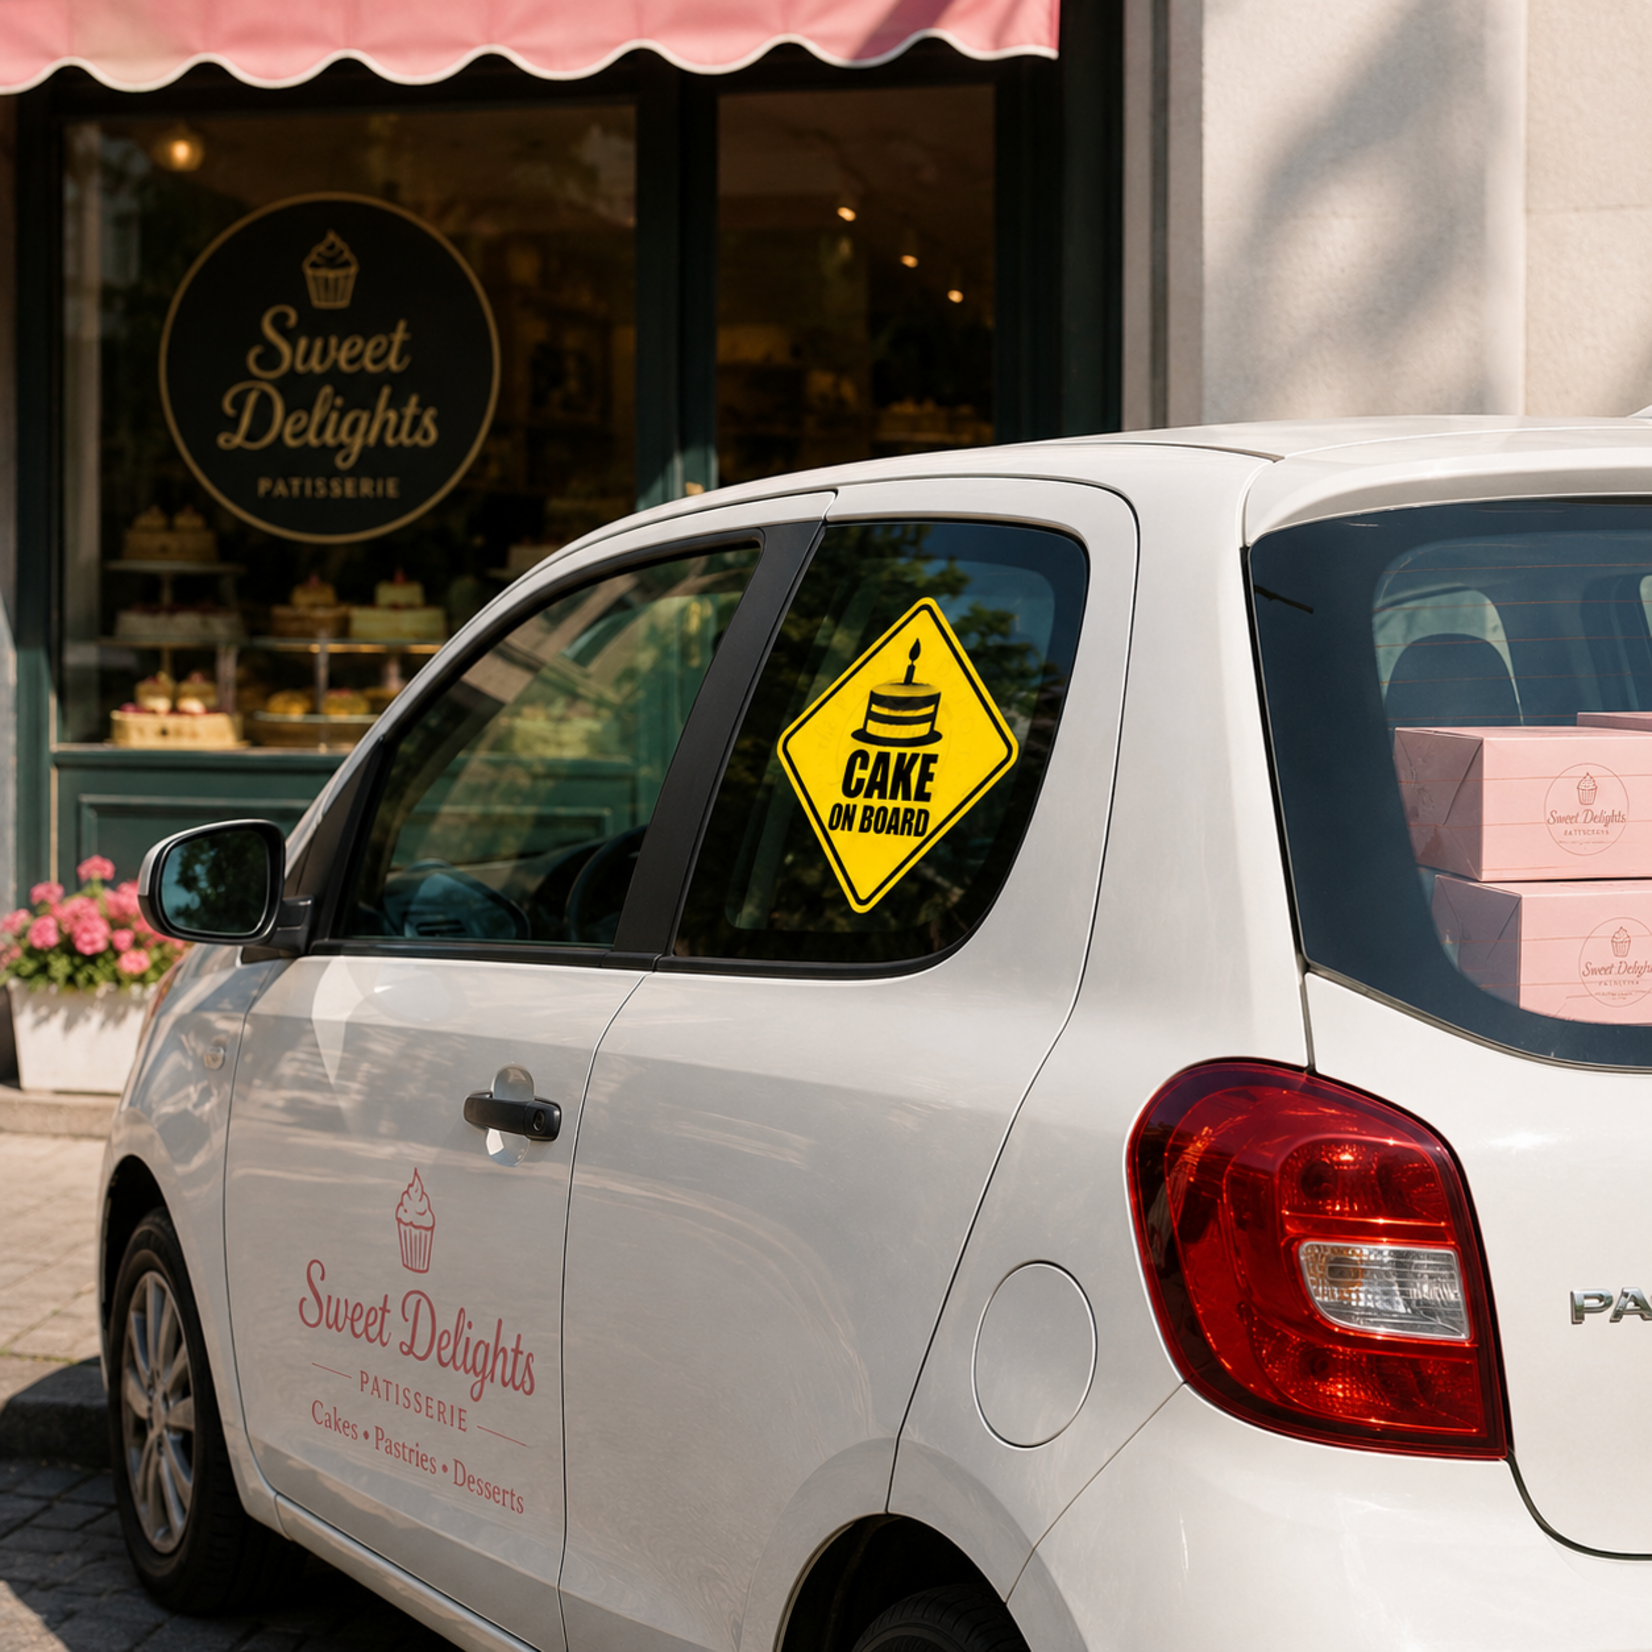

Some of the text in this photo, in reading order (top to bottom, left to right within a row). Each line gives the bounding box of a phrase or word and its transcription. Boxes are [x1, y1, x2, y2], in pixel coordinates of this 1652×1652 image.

[246, 304, 412, 380] Sweet
[216, 380, 438, 471] Delights
[257, 476, 400, 499] PATISSERIE
[841, 748, 939, 803] CAKE
[828, 803, 930, 837] ON BOARD
[1546, 808, 1627, 828] Sweet Delights
[1581, 961, 1614, 977] Sweet
[298, 1259, 535, 1402] Sweet Delights
[1570, 1287, 1652, 1325] PA
[360, 1370, 468, 1432] PATISSERIE
[312, 1400, 524, 1514] Cakes Pastries Desserts
